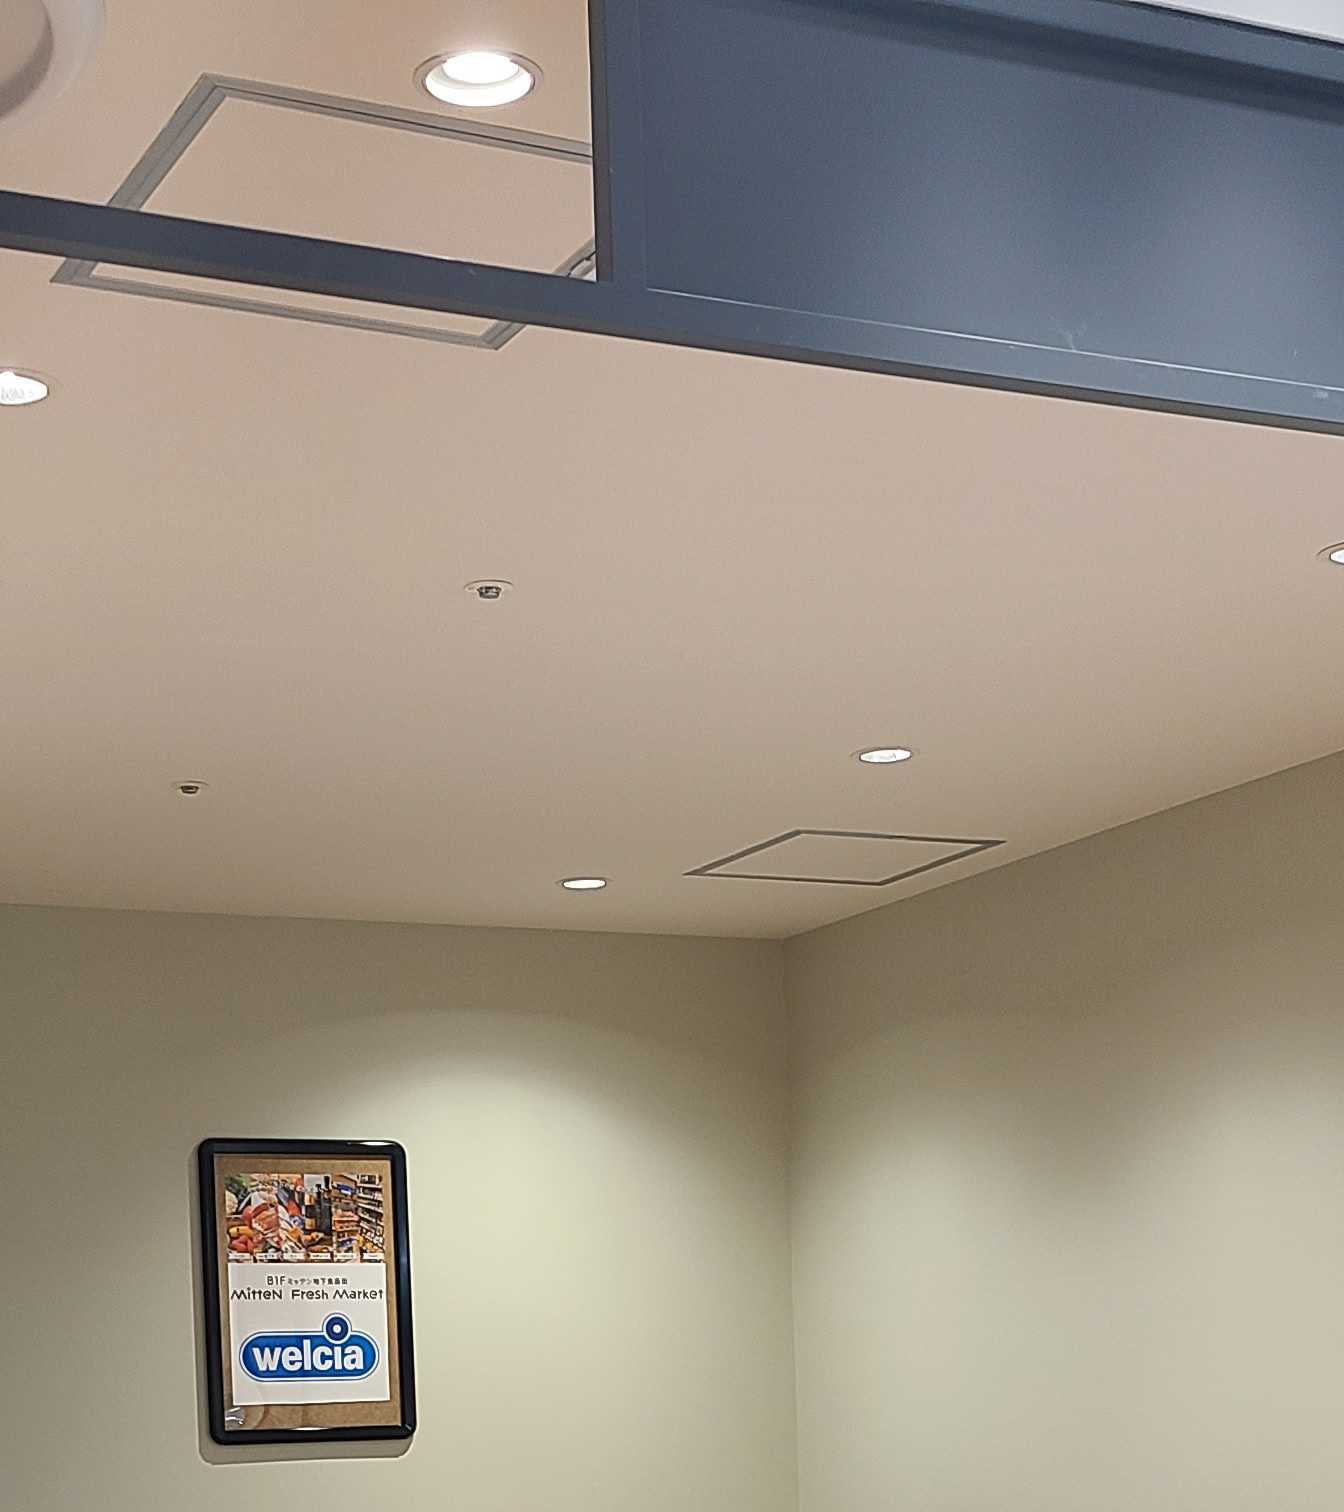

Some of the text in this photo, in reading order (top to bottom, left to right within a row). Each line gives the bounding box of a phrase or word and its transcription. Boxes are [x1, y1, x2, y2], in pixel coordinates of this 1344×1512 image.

[266, 1275, 286, 1286] B1F
[230, 1287, 384, 1300] MitteN Fresh Market
[252, 1317, 364, 1372] welcia
